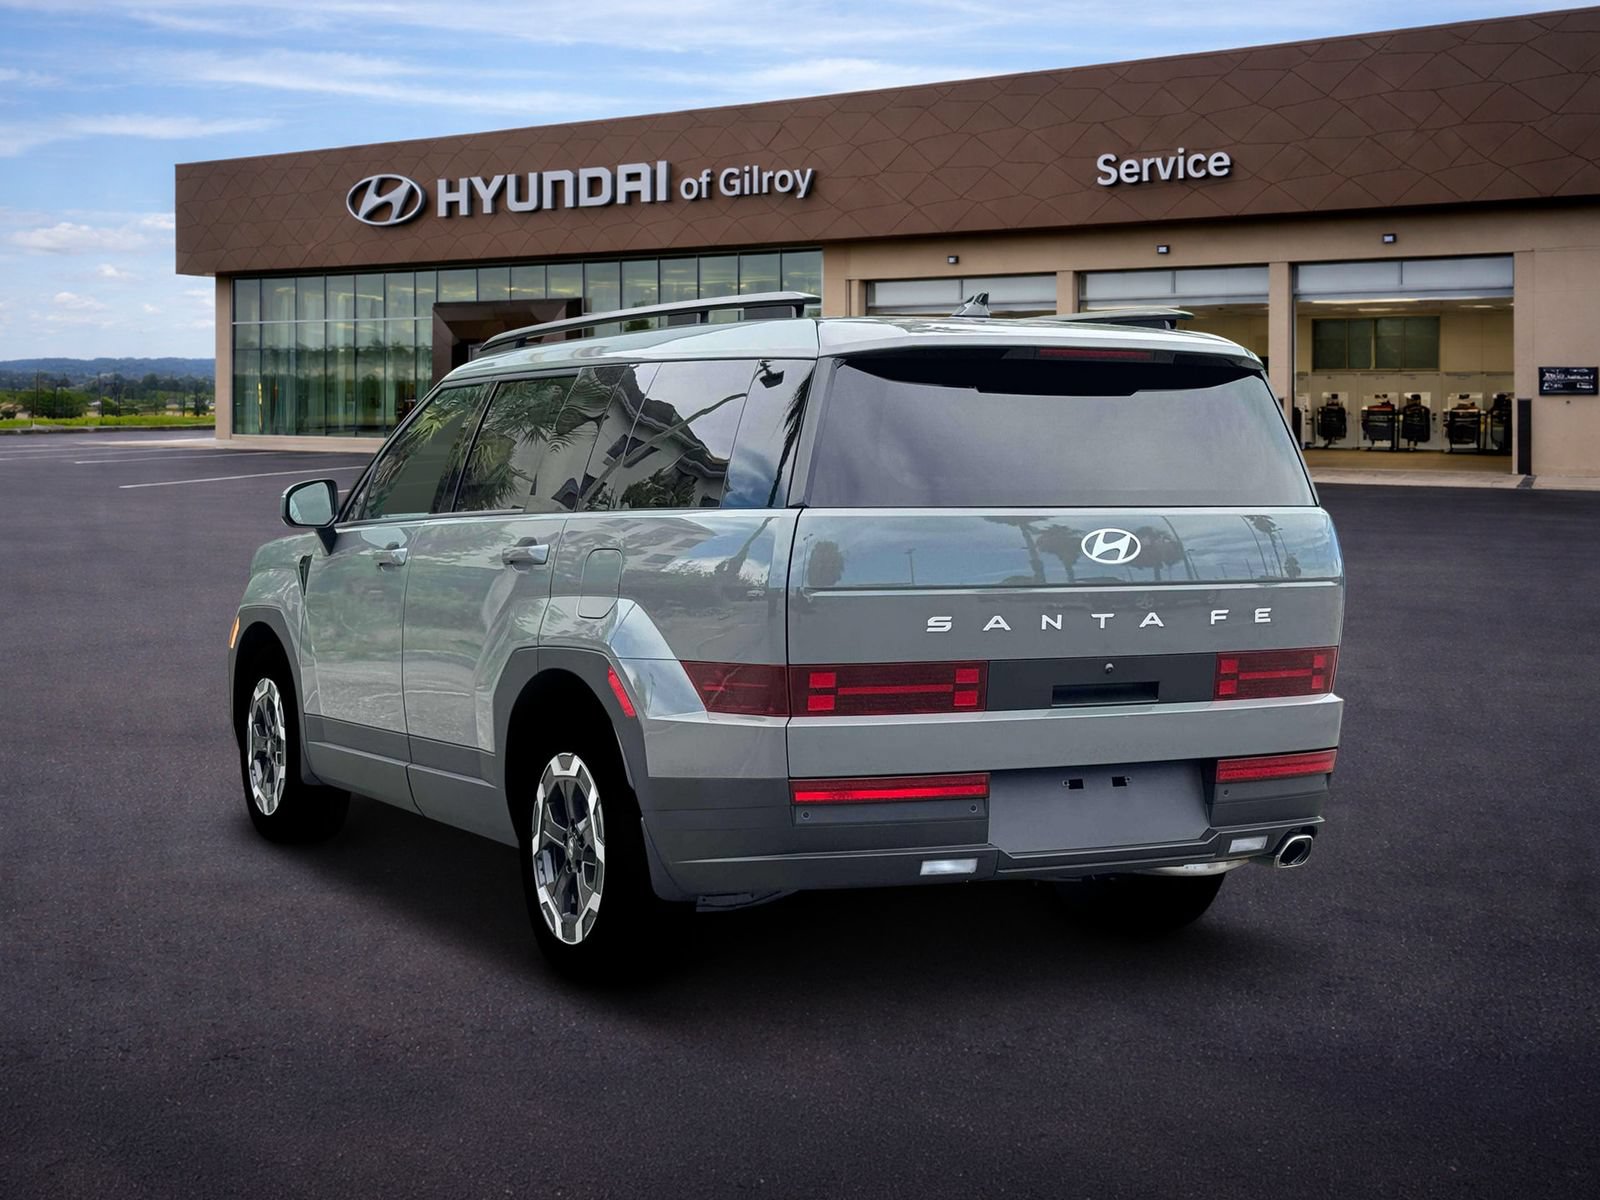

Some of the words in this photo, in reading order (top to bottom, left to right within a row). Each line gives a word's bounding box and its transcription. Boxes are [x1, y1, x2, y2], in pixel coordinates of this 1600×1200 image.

[1096, 147, 1231, 186] Service
[437, 160, 669, 217] HYUNDAI
[680, 170, 711, 200] of
[718, 165, 813, 198] Gilroy
[926, 612, 1165, 632] SANTA
[1210, 607, 1272, 625] FE
